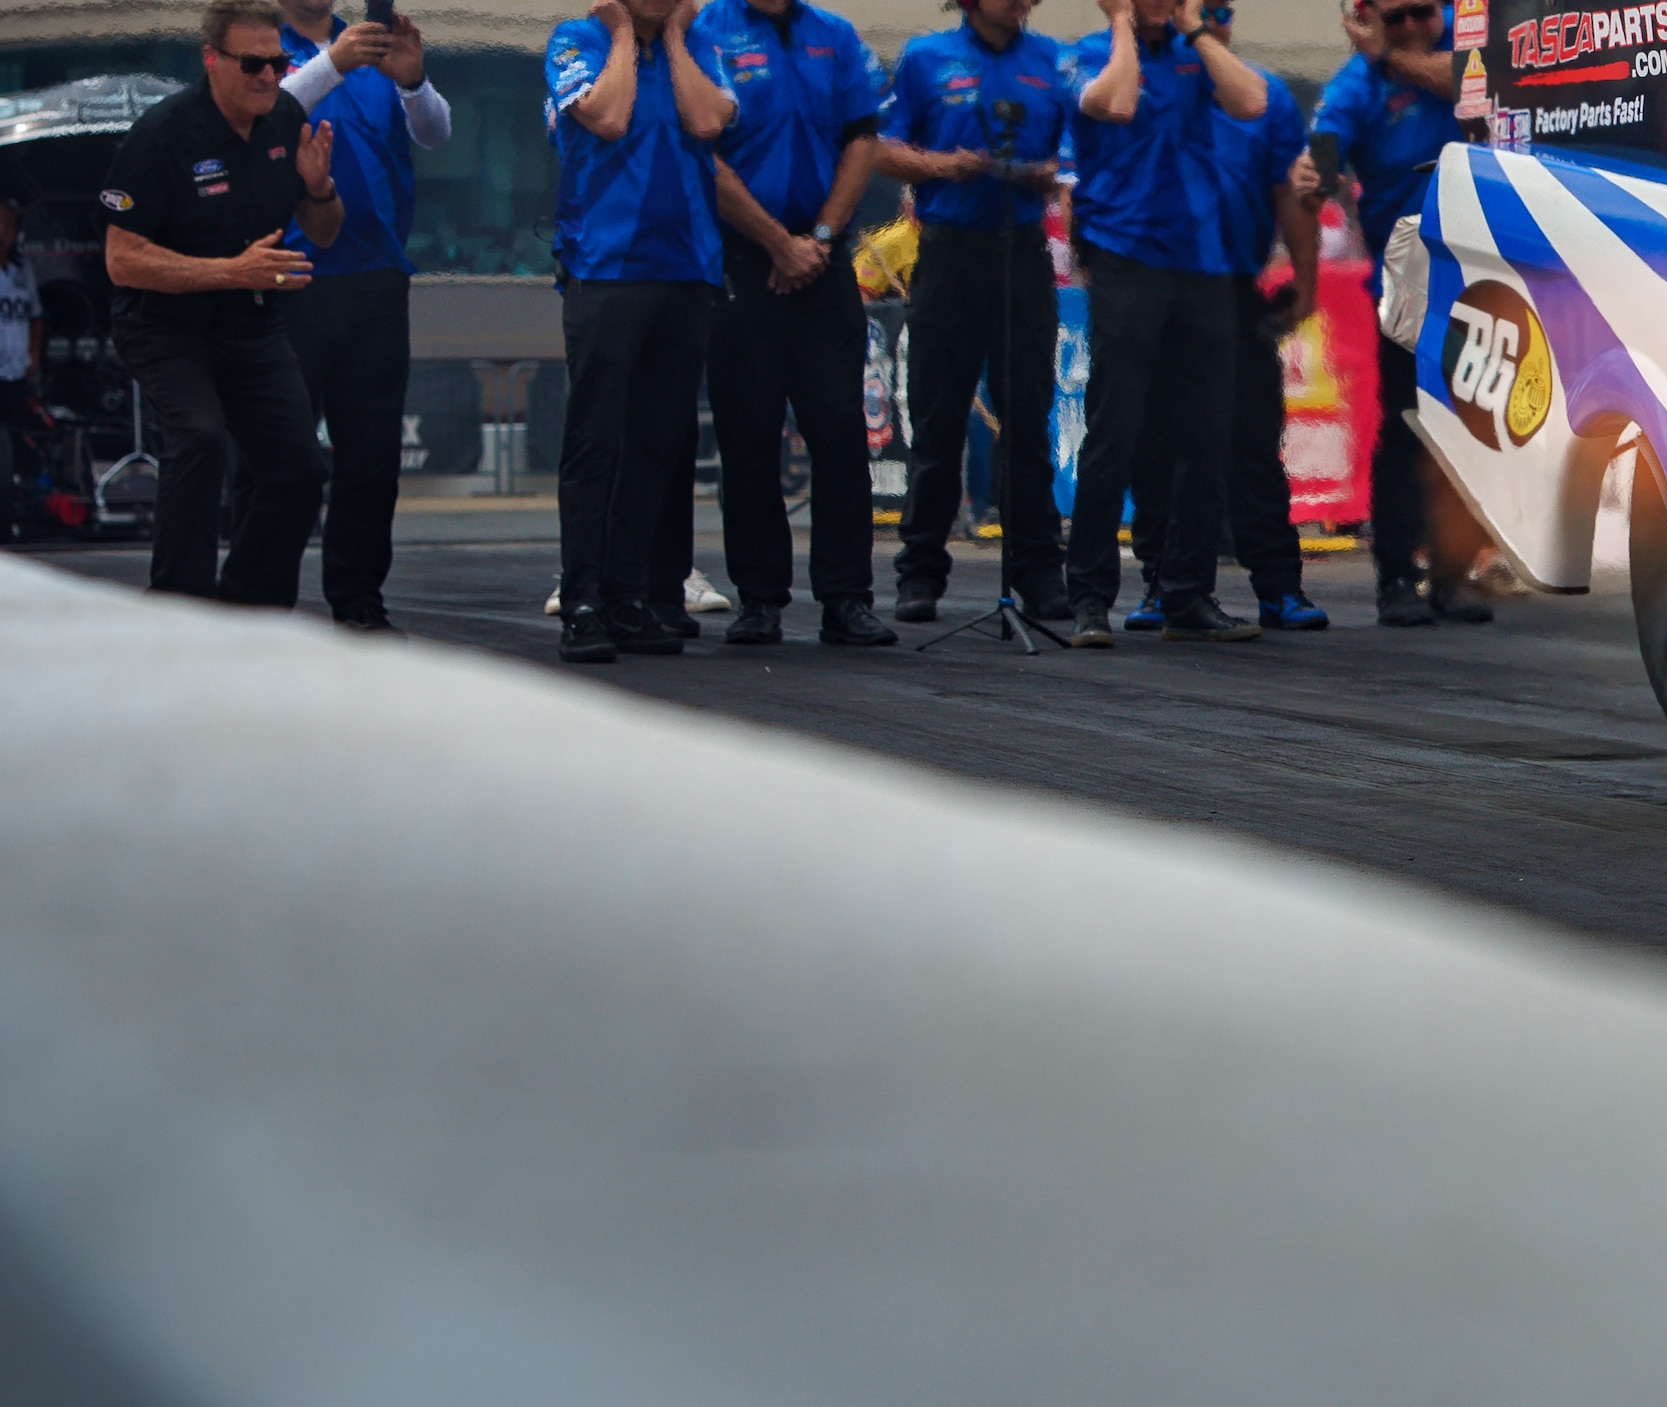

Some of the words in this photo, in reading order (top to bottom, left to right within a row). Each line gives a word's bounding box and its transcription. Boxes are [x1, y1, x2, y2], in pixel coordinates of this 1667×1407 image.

[1535, 106, 1578, 135] Factory
[1579, 100, 1611, 129] Parts
[1613, 94, 1645, 125] Fast!
[1450, 301, 1520, 451] BG
